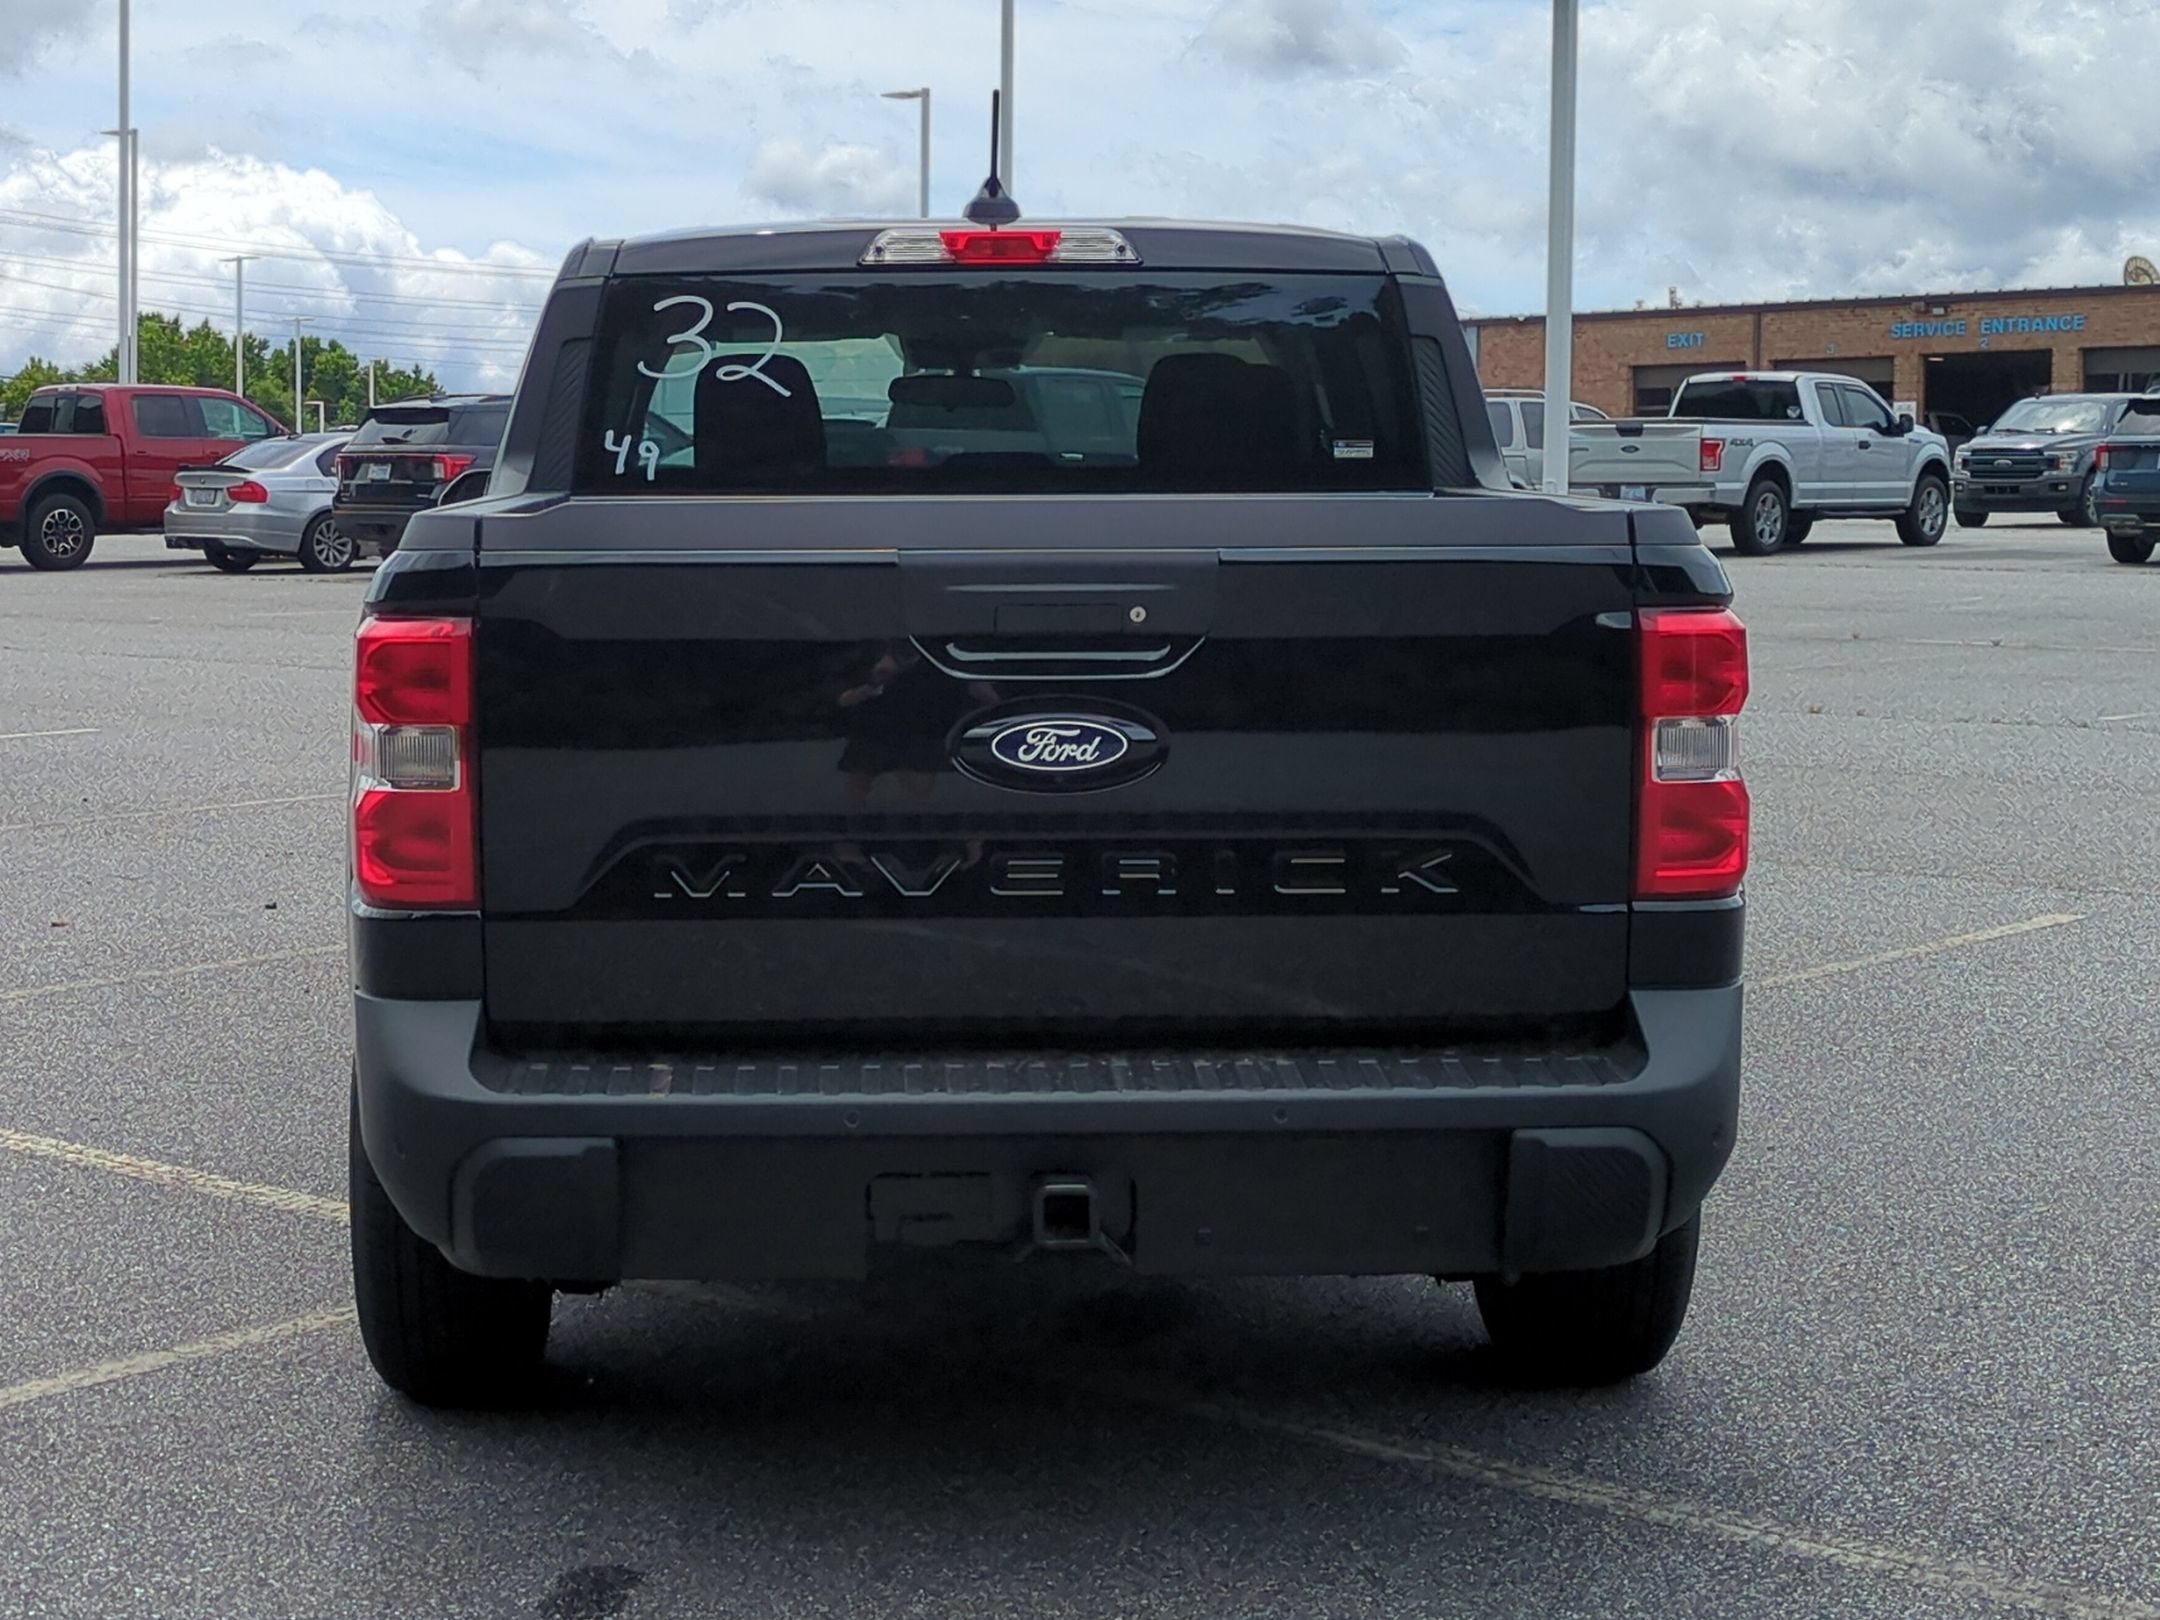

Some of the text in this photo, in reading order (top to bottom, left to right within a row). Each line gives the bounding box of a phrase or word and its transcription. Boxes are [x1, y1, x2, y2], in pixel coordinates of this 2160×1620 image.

[1667, 332, 1706, 348] EXIT
[1890, 314, 2086, 338] SERVICE ENTRANCE
[1979, 337, 1990, 349] 2
[637, 295, 792, 397] 32
[604, 429, 660, 481] 49
[1017, 727, 1102, 762] Ford
[653, 852, 1459, 898] MAVERICK
